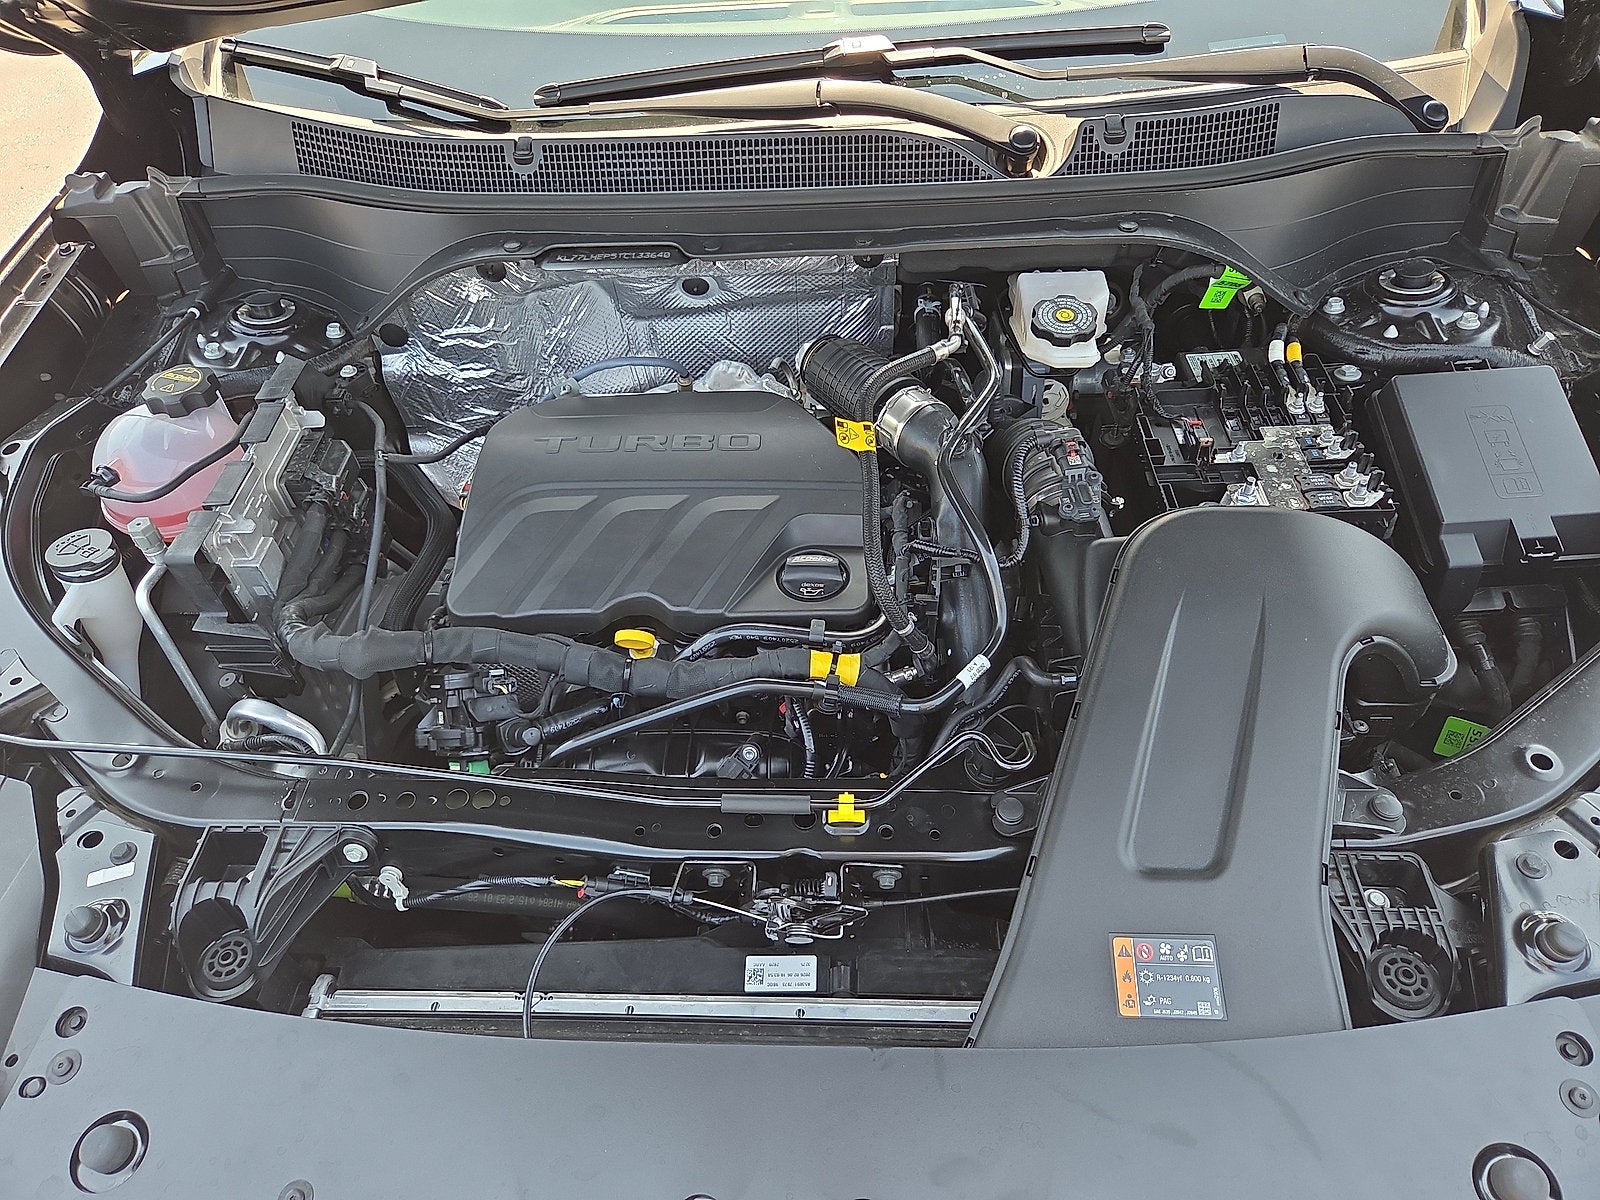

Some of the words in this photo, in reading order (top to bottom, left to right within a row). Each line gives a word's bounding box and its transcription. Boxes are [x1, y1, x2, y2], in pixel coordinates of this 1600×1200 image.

[534, 433, 762, 454] TURBO
[1201, 976, 1211, 984] kg
[1159, 997, 1172, 1005] PAG
